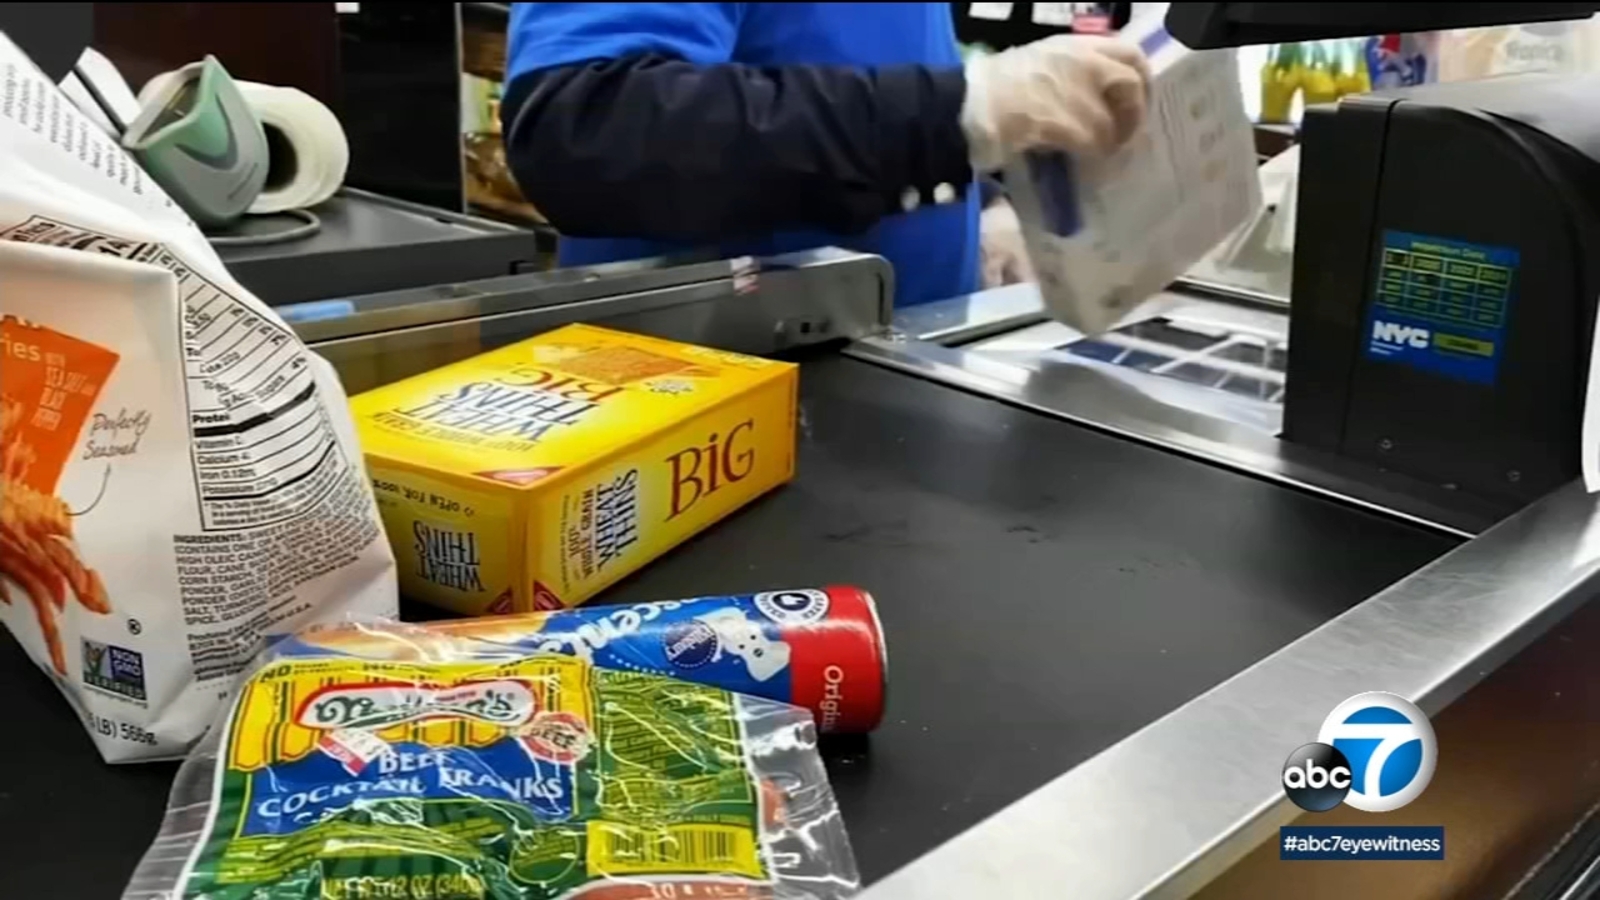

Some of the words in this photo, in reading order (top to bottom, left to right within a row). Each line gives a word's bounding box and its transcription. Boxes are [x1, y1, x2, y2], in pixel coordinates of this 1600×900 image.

[1371, 320, 1430, 349] NYC
[393, 399, 554, 443] WHEAT
[439, 381, 601, 426] THINS
[595, 482, 615, 573] WHEAT
[614, 468, 638, 558] THINS
[174, 533, 246, 544] INGREDIENTS:
[415, 555, 486, 593] WHEAT
[818, 664, 845, 733] Origin
[378, 750, 452, 775] BEEF
[256, 775, 428, 820] COCKTAIL
